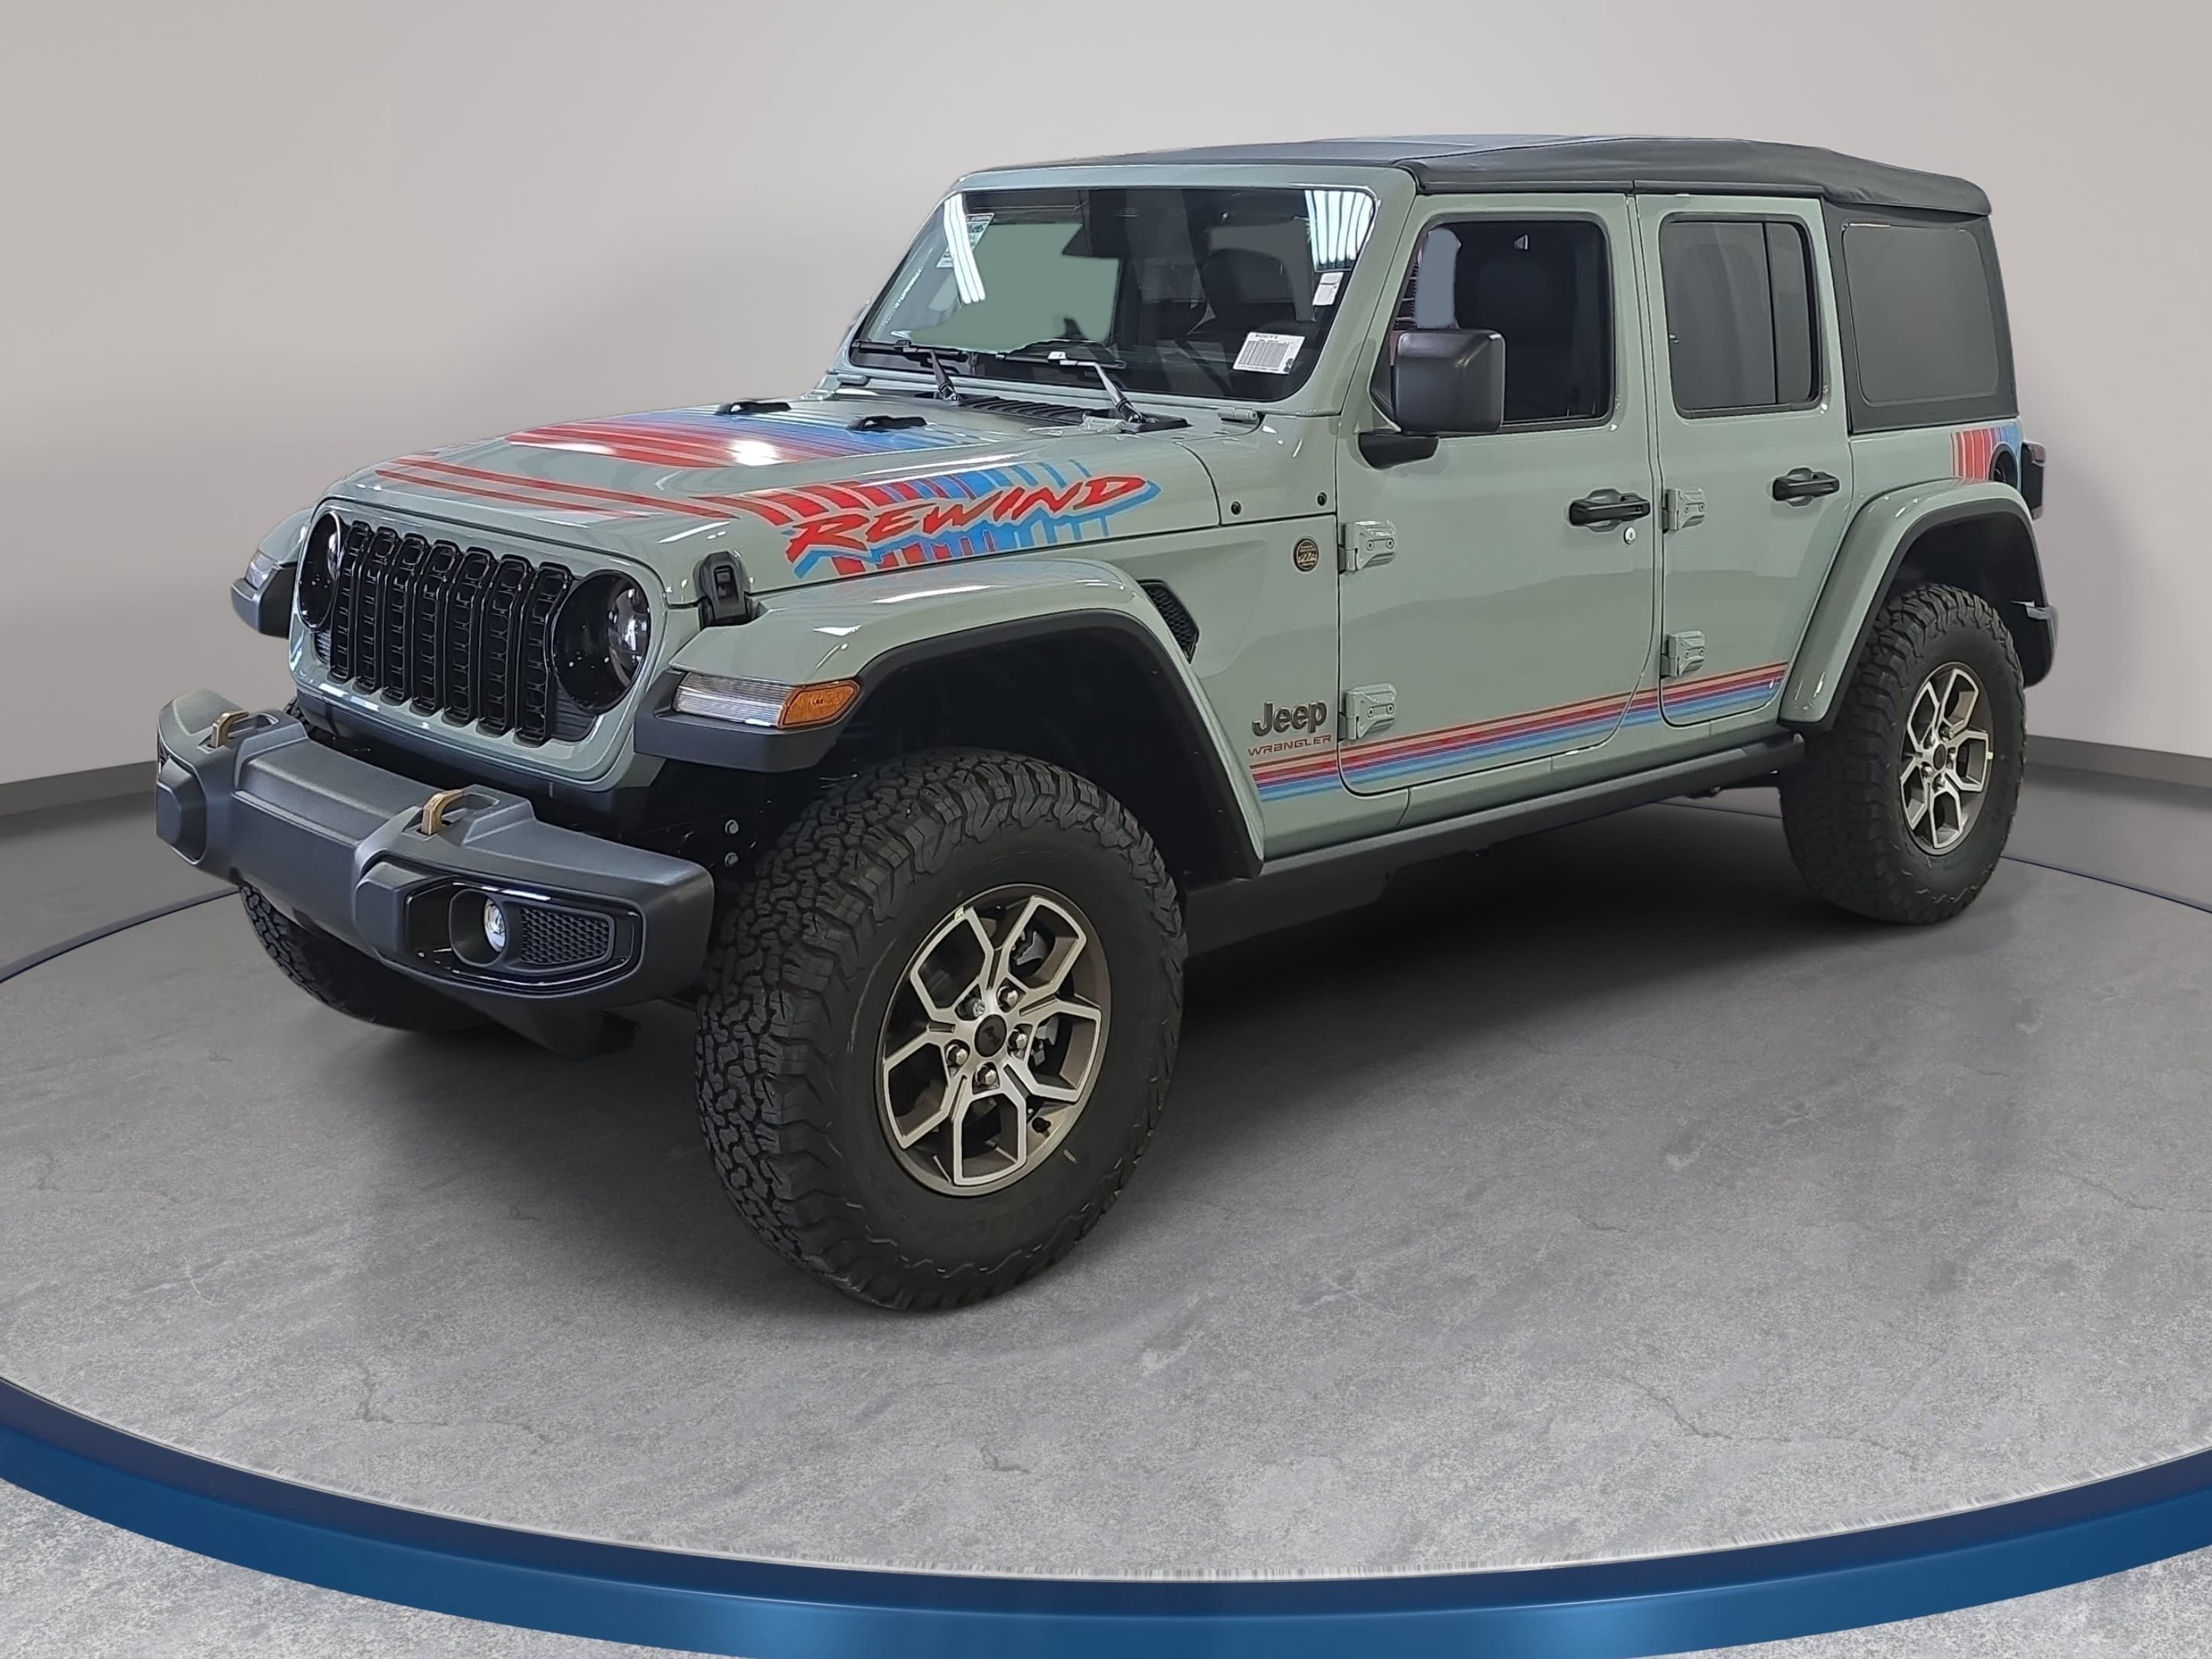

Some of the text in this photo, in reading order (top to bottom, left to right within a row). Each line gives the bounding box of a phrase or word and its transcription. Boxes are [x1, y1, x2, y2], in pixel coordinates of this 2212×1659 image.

[785, 475, 1147, 565] REWIND
[1251, 701, 1327, 736] Jeep
[1248, 735, 1332, 756] WRANGLER
